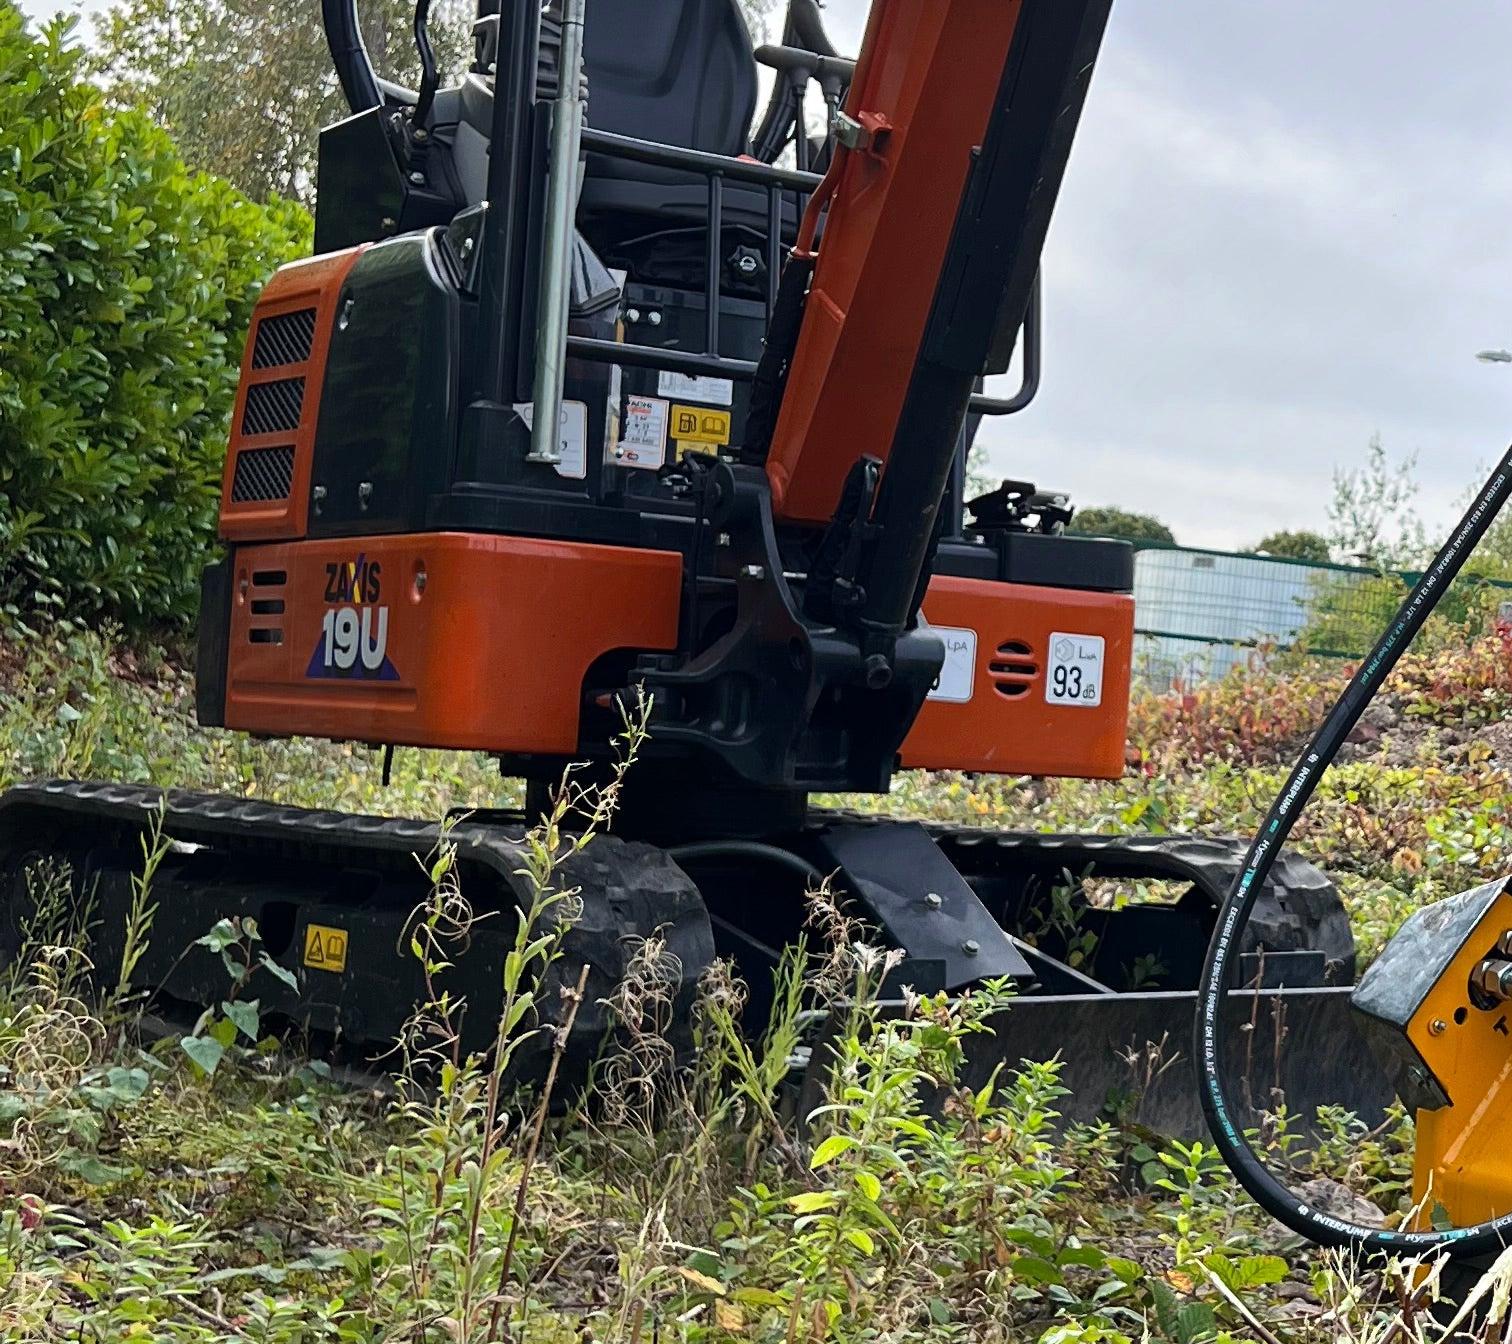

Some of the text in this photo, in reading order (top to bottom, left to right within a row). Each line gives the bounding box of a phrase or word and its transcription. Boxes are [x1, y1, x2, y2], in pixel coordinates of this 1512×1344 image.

[1485, 474, 1506, 502] EXCEEDS
[324, 553, 381, 604] ZAXIS
[323, 607, 388, 670] 19U
[1053, 665, 1096, 699] 93 dB
[1279, 766, 1310, 814] INTERPUMP
[1222, 906, 1238, 937] EXCEEDS
[1312, 1212, 1373, 1238] INTERPUMP
